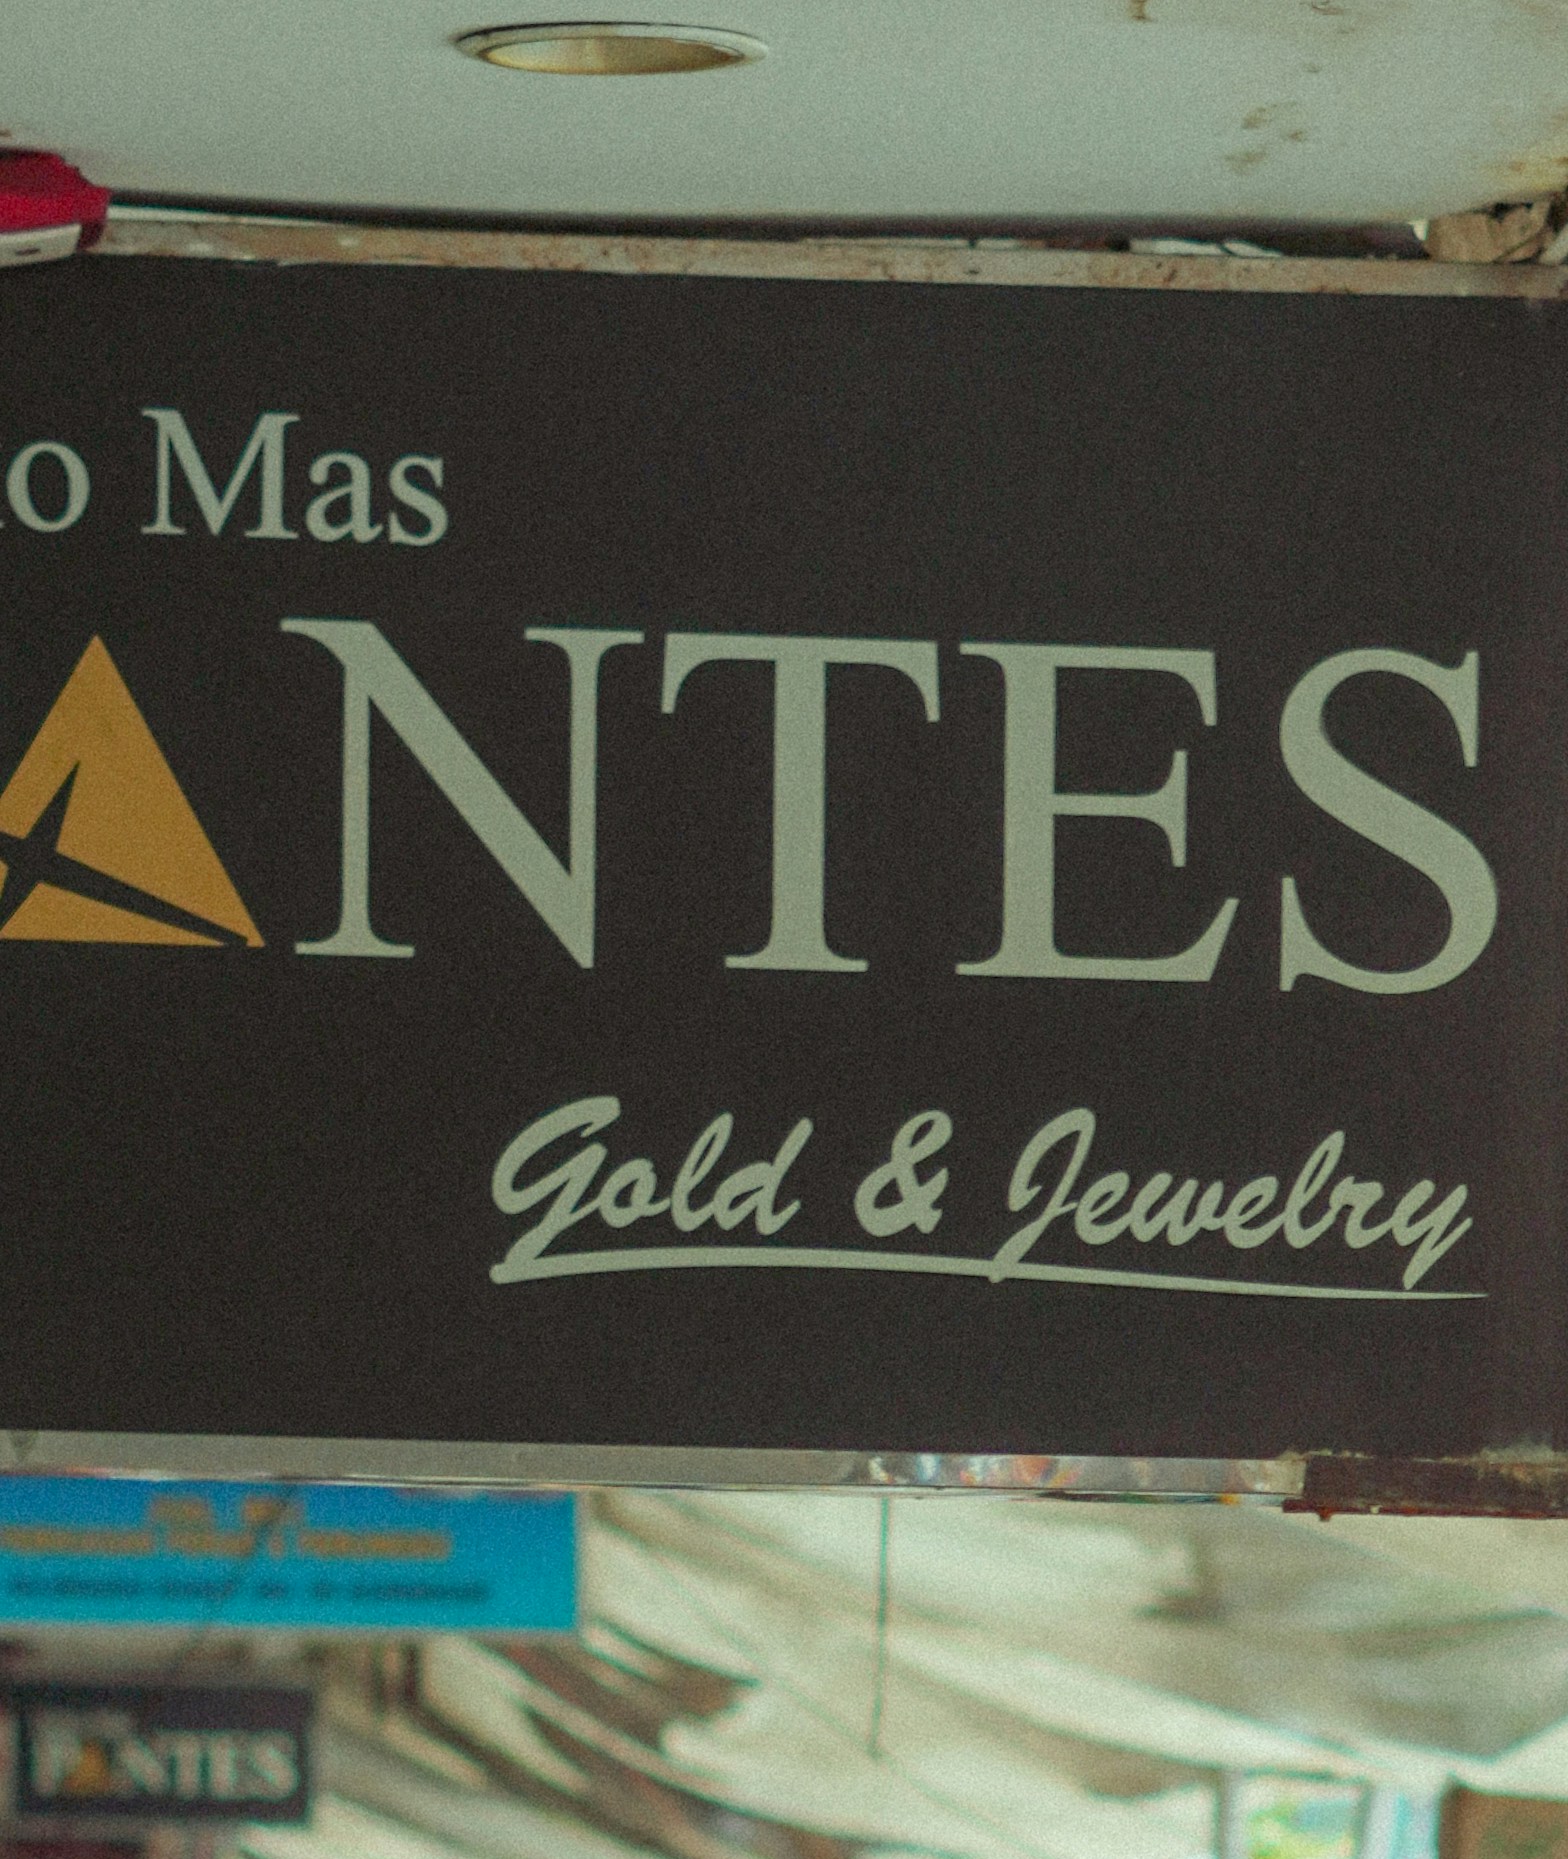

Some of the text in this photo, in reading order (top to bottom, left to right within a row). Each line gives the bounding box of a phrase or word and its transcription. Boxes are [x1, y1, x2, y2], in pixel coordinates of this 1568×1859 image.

[0, 406, 449, 546] o Mas
[490, 1094, 1473, 1290] Gold & Jewelry
